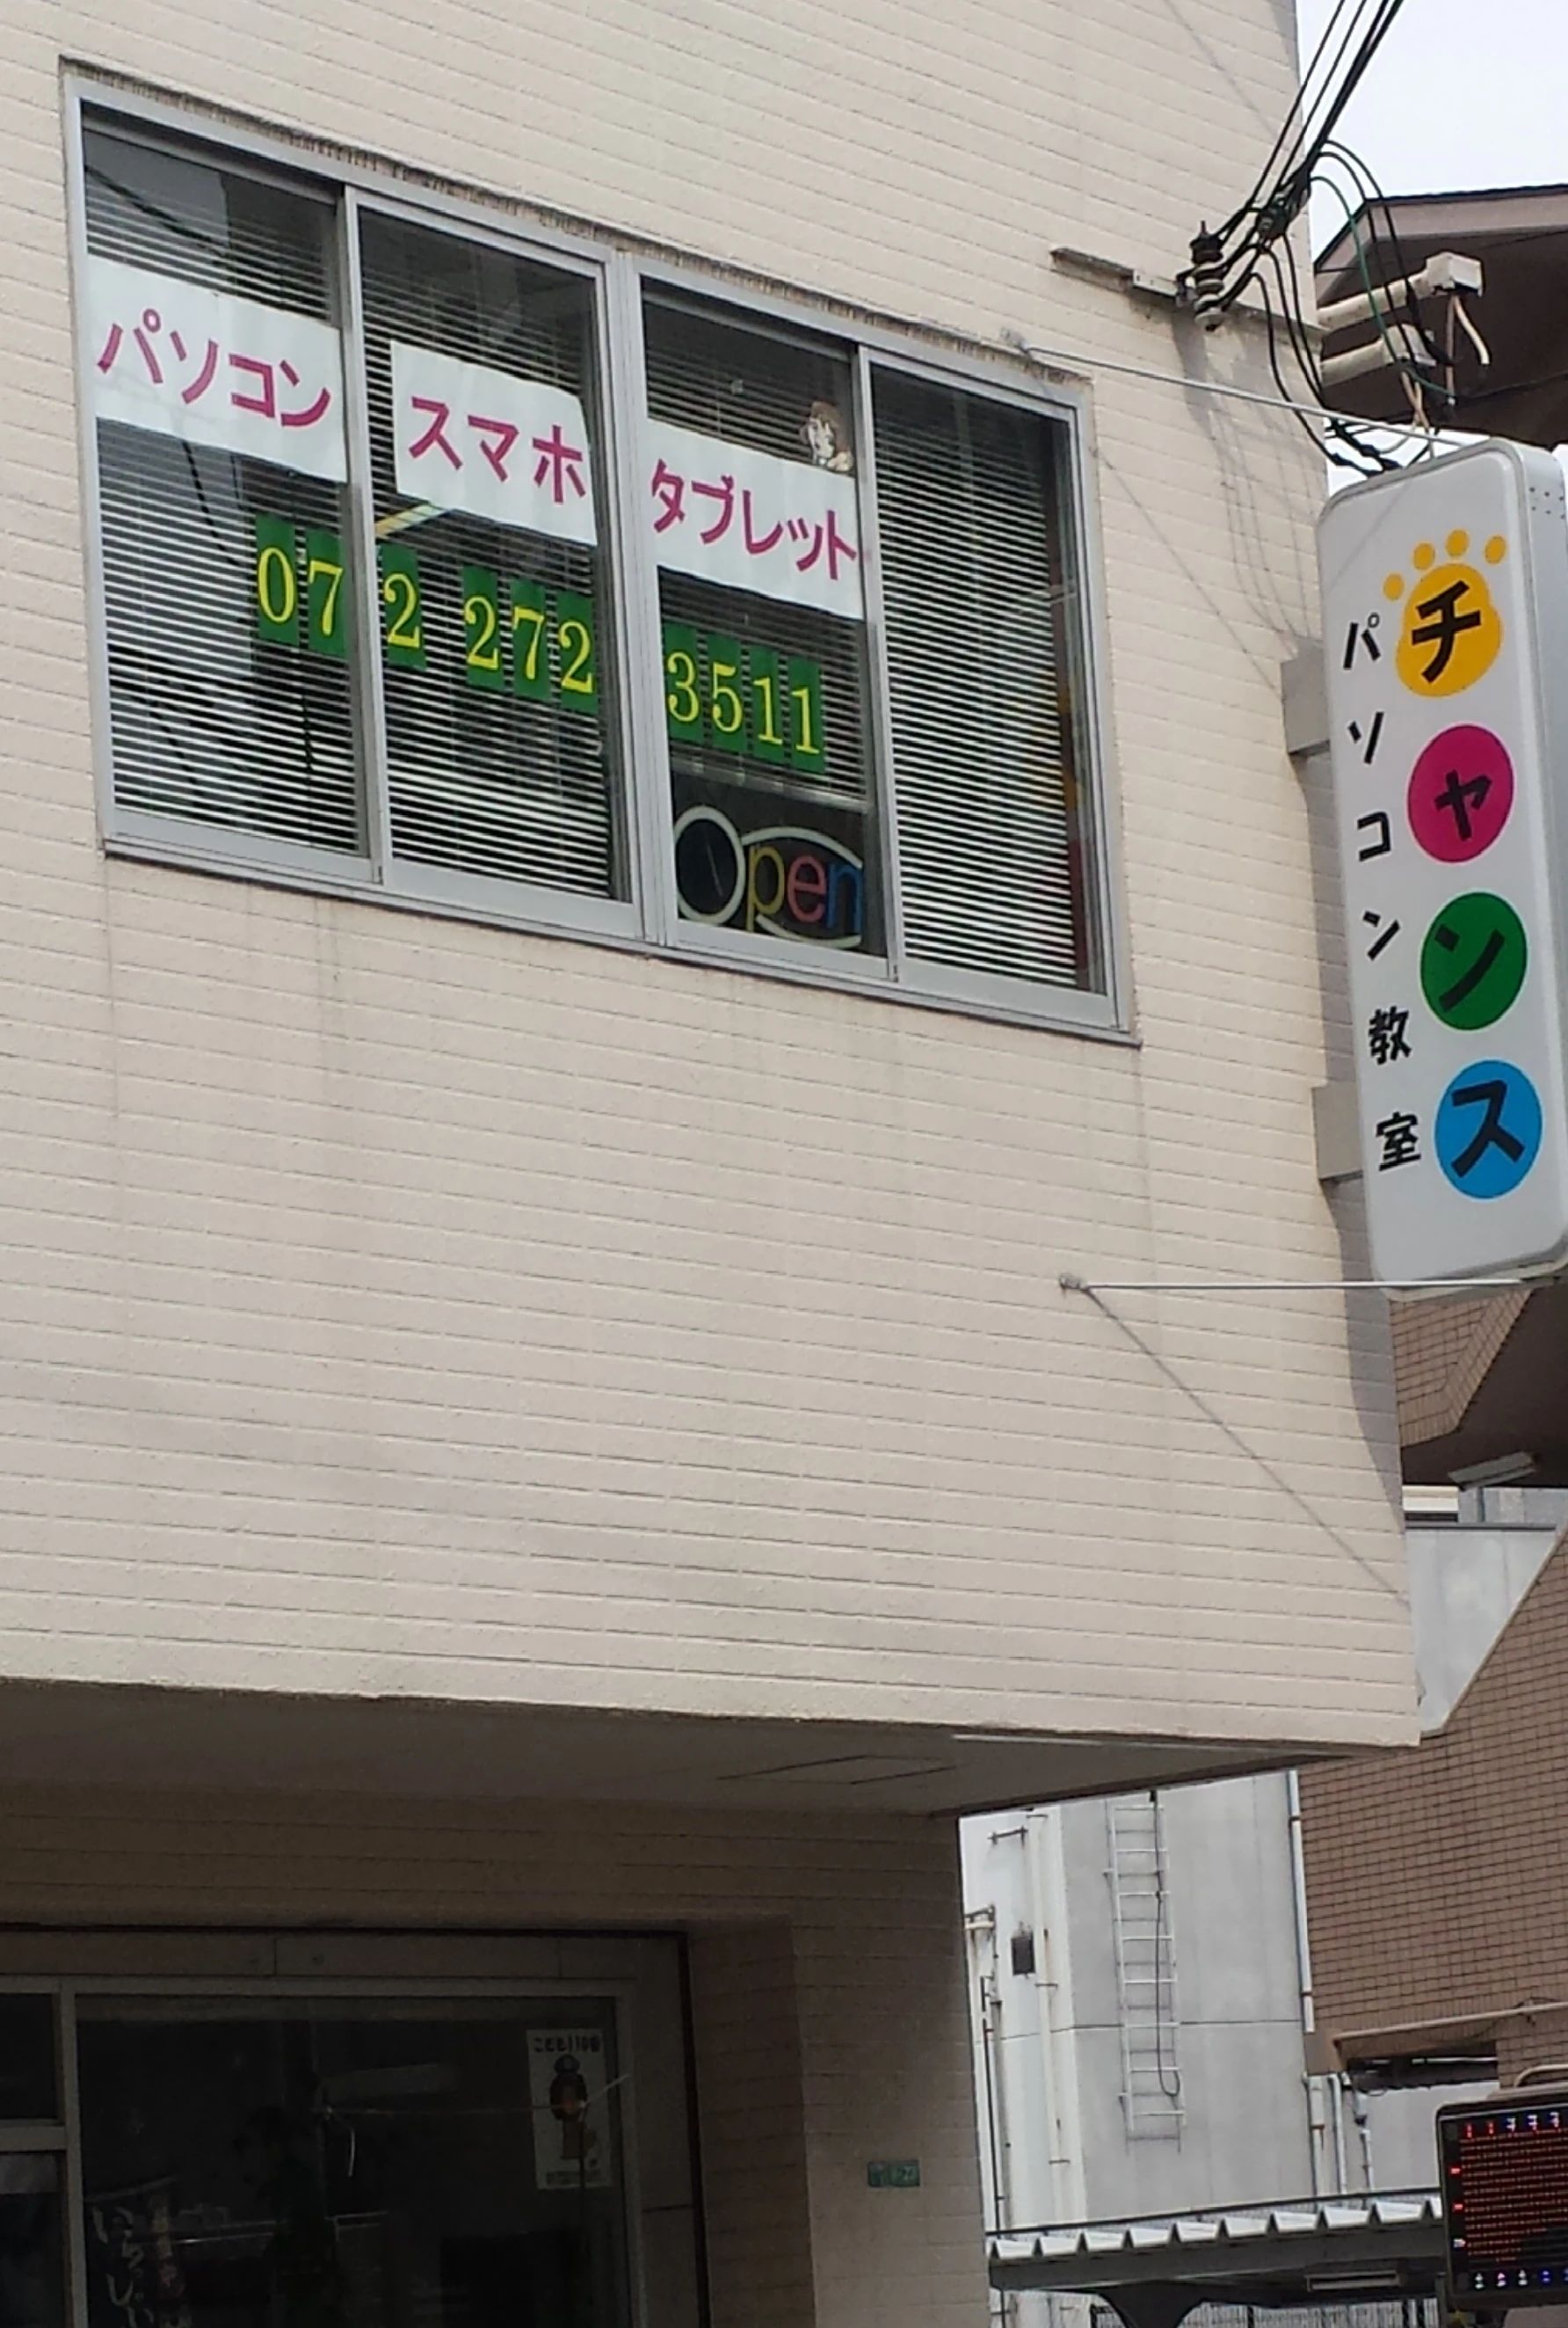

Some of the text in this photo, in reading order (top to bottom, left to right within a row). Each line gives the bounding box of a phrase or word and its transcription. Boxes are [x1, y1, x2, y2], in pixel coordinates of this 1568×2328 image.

[97, 308, 331, 428] パソコン
[409, 396, 586, 504] スマホ
[651, 459, 858, 579] タブレット
[257, 547, 819, 754] 072 272 3511
[674, 805, 864, 932] Open
[1343, 612, 1422, 1172] パソコン教室
